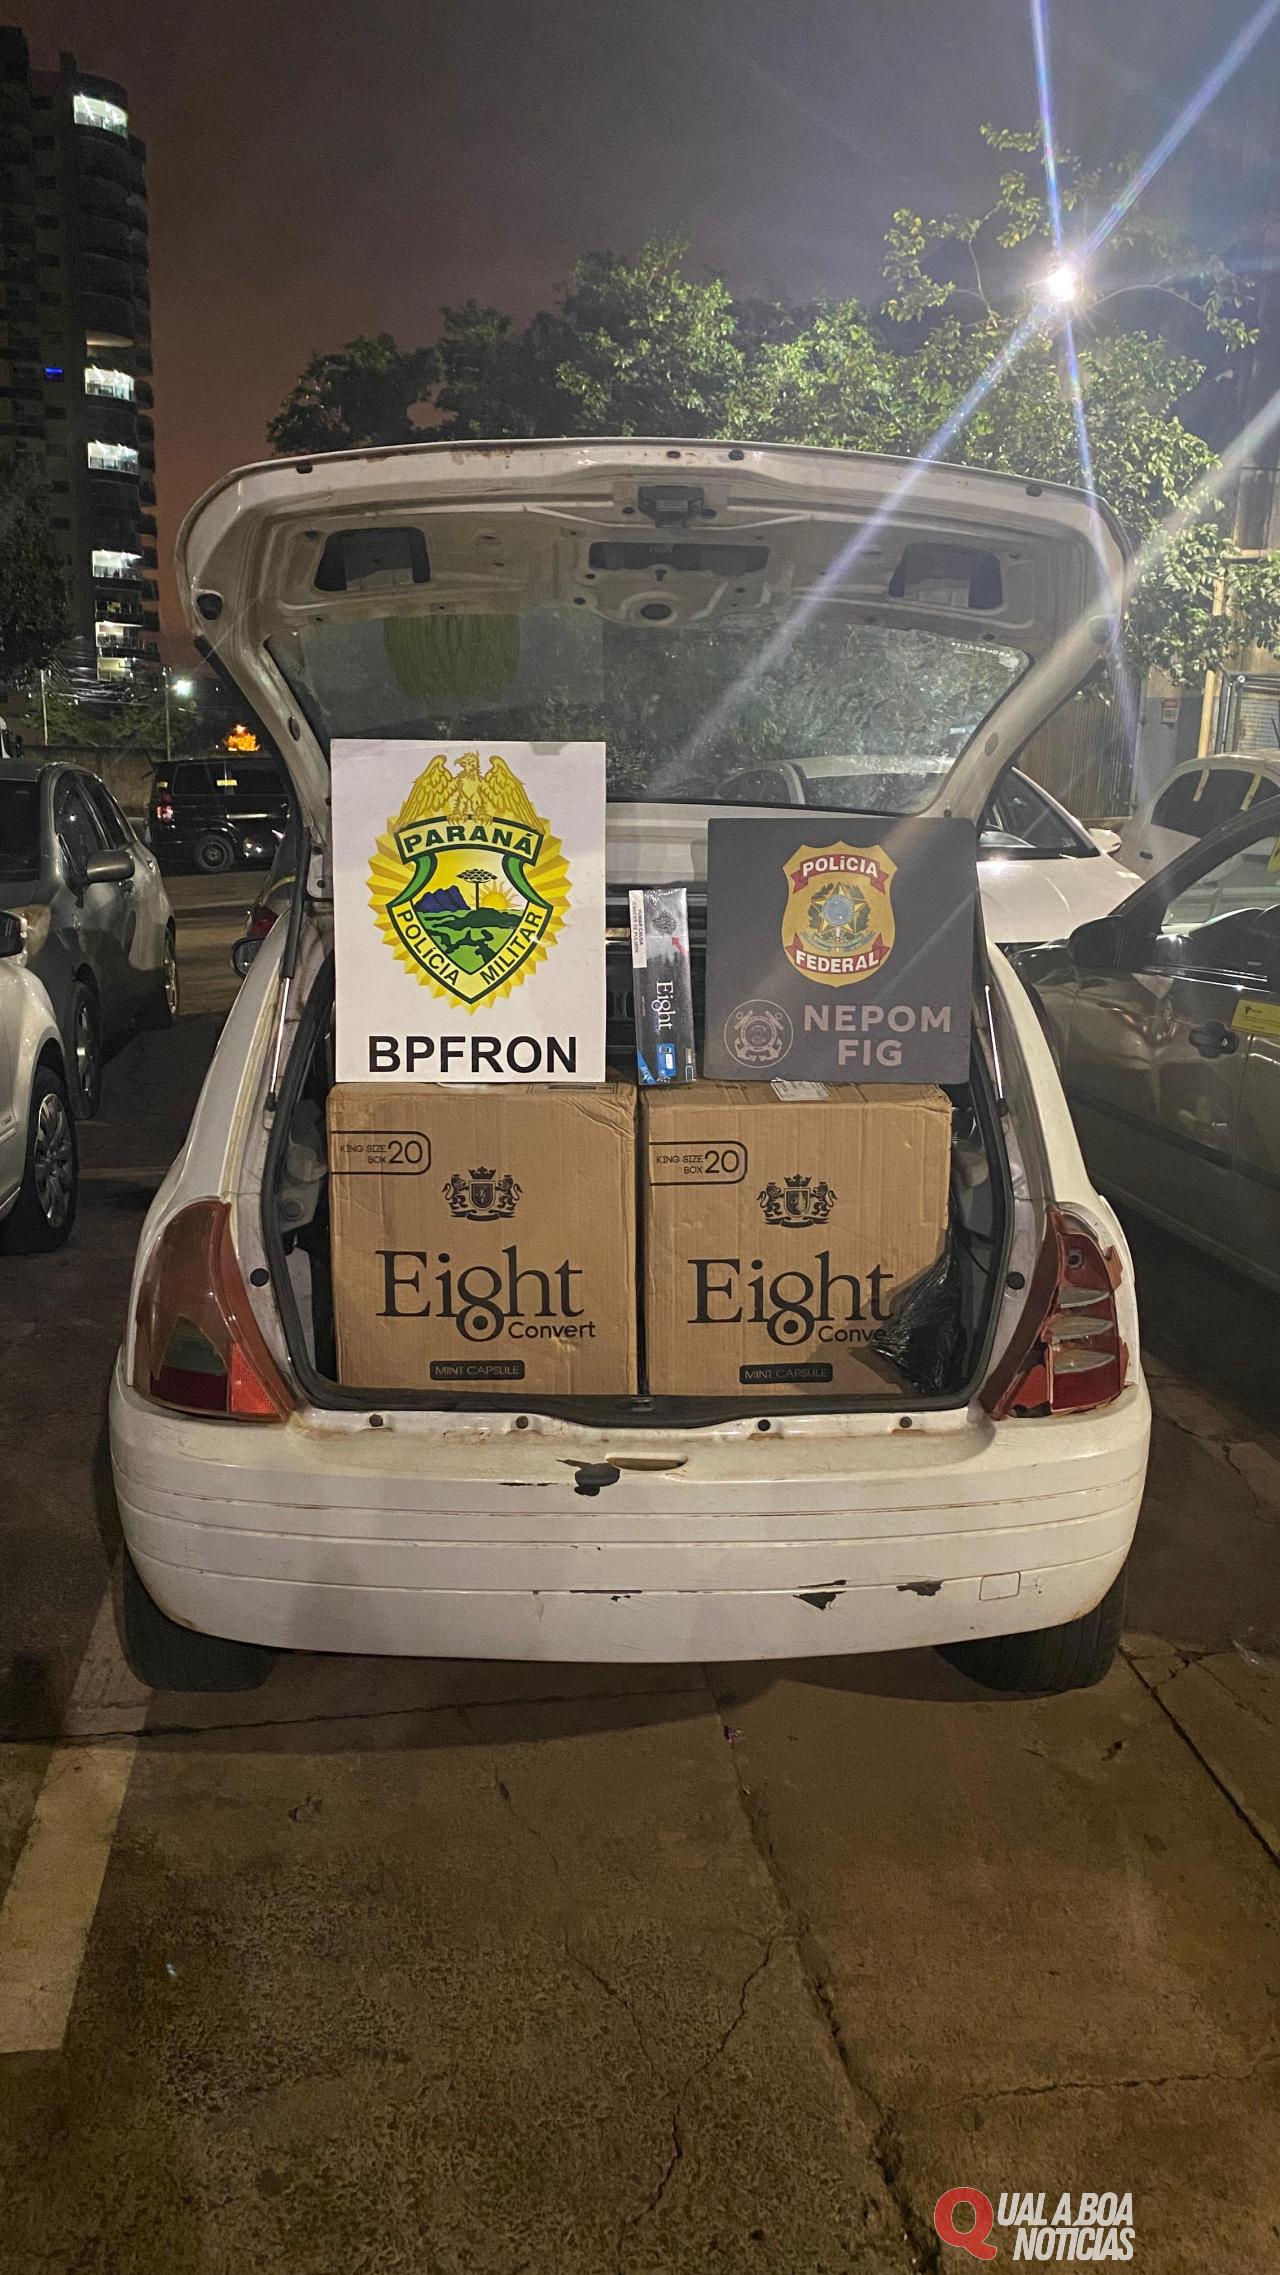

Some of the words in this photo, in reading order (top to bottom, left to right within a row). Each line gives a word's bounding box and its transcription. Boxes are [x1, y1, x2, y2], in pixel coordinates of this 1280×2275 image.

[403, 825, 535, 856] PARANÁ
[396, 910, 461, 986] POLÍCIA
[479, 911, 543, 986] MILITAR
[795, 950, 879, 973] FEDERAL
[651, 980, 677, 1031] Eight
[804, 1005, 950, 1033] NEPOM
[368, 1036, 577, 1074] BPFRON
[838, 1039, 902, 1066] FIG
[340, 1145, 364, 1153] KING
[366, 1145, 387, 1153] SIZE
[367, 1156, 387, 1164] BOX
[388, 1140, 423, 1164] 20
[656, 1155, 680, 1164] KING
[683, 1155, 703, 1163] SIZE
[684, 1166, 703, 1174] BOX
[705, 1150, 740, 1174] 20
[375, 1244, 584, 1342] Eight
[687, 1250, 894, 1345] Eight
[508, 1320, 596, 1339] Convert
[818, 1325, 887, 1343] Conve
[435, 1366, 464, 1375] MINT
[466, 1365, 519, 1375] CAPSULE
[744, 1370, 773, 1379] MINT
[775, 1368, 828, 1378] CAPSULE
